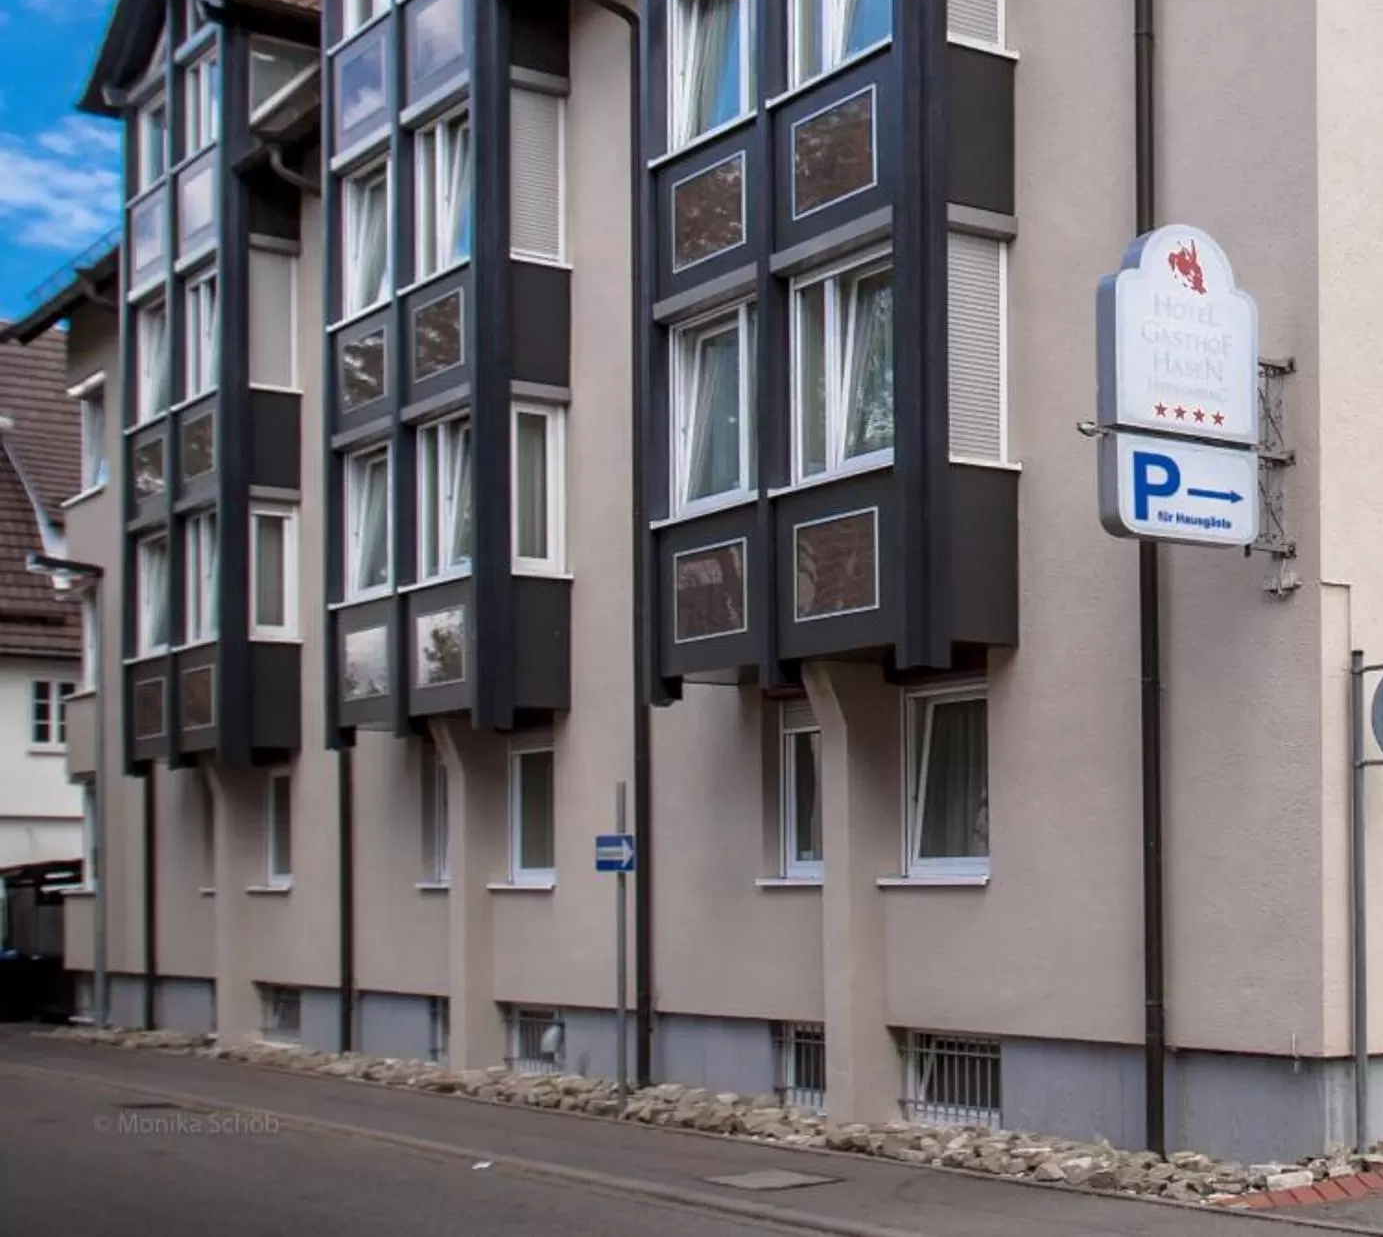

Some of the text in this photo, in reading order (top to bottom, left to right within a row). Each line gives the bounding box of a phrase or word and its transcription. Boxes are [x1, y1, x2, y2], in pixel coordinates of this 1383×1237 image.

[1153, 294, 1222, 327] HOTEL
[1140, 320, 1233, 356] GASTHOF
[1134, 451, 1180, 520] P
